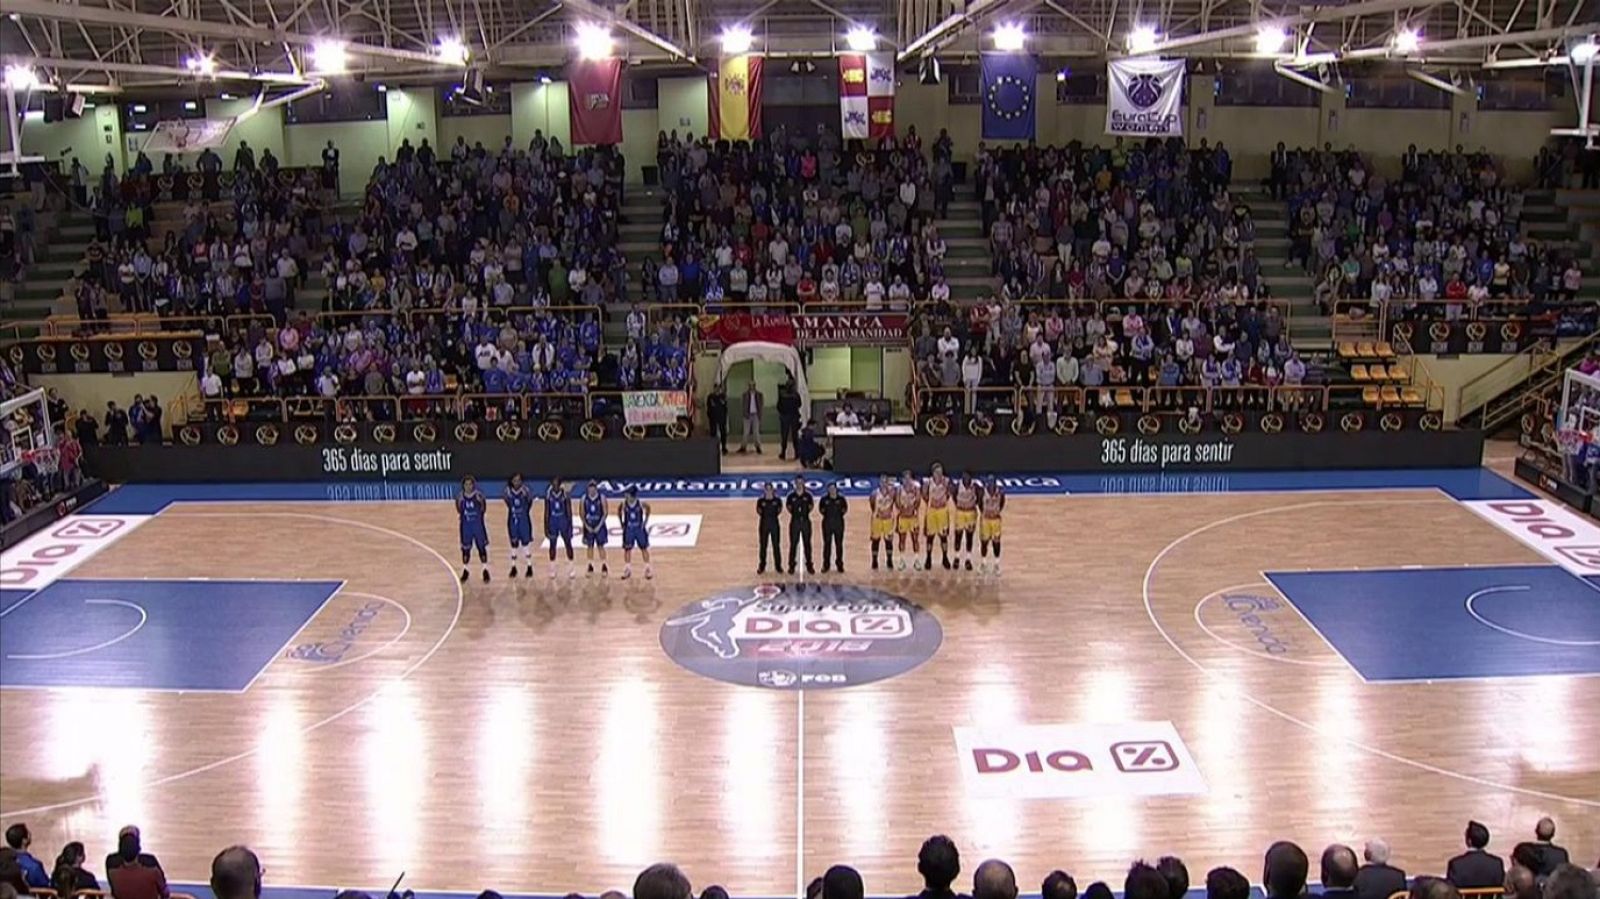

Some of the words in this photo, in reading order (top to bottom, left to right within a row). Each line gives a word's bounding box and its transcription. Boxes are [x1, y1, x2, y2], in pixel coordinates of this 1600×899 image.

[797, 328, 813, 339] DE
[816, 328, 831, 339] LA
[833, 328, 902, 339] HUMANIDAD
[322, 447, 347, 472] 365
[351, 446, 378, 472] días
[381, 453, 410, 477] para
[414, 446, 451, 471] sentir
[1101, 438, 1126, 463] 365
[1130, 438, 1157, 463] días
[1161, 444, 1191, 468] para
[1194, 437, 1234, 462] sentir
[835, 478, 871, 489] de
